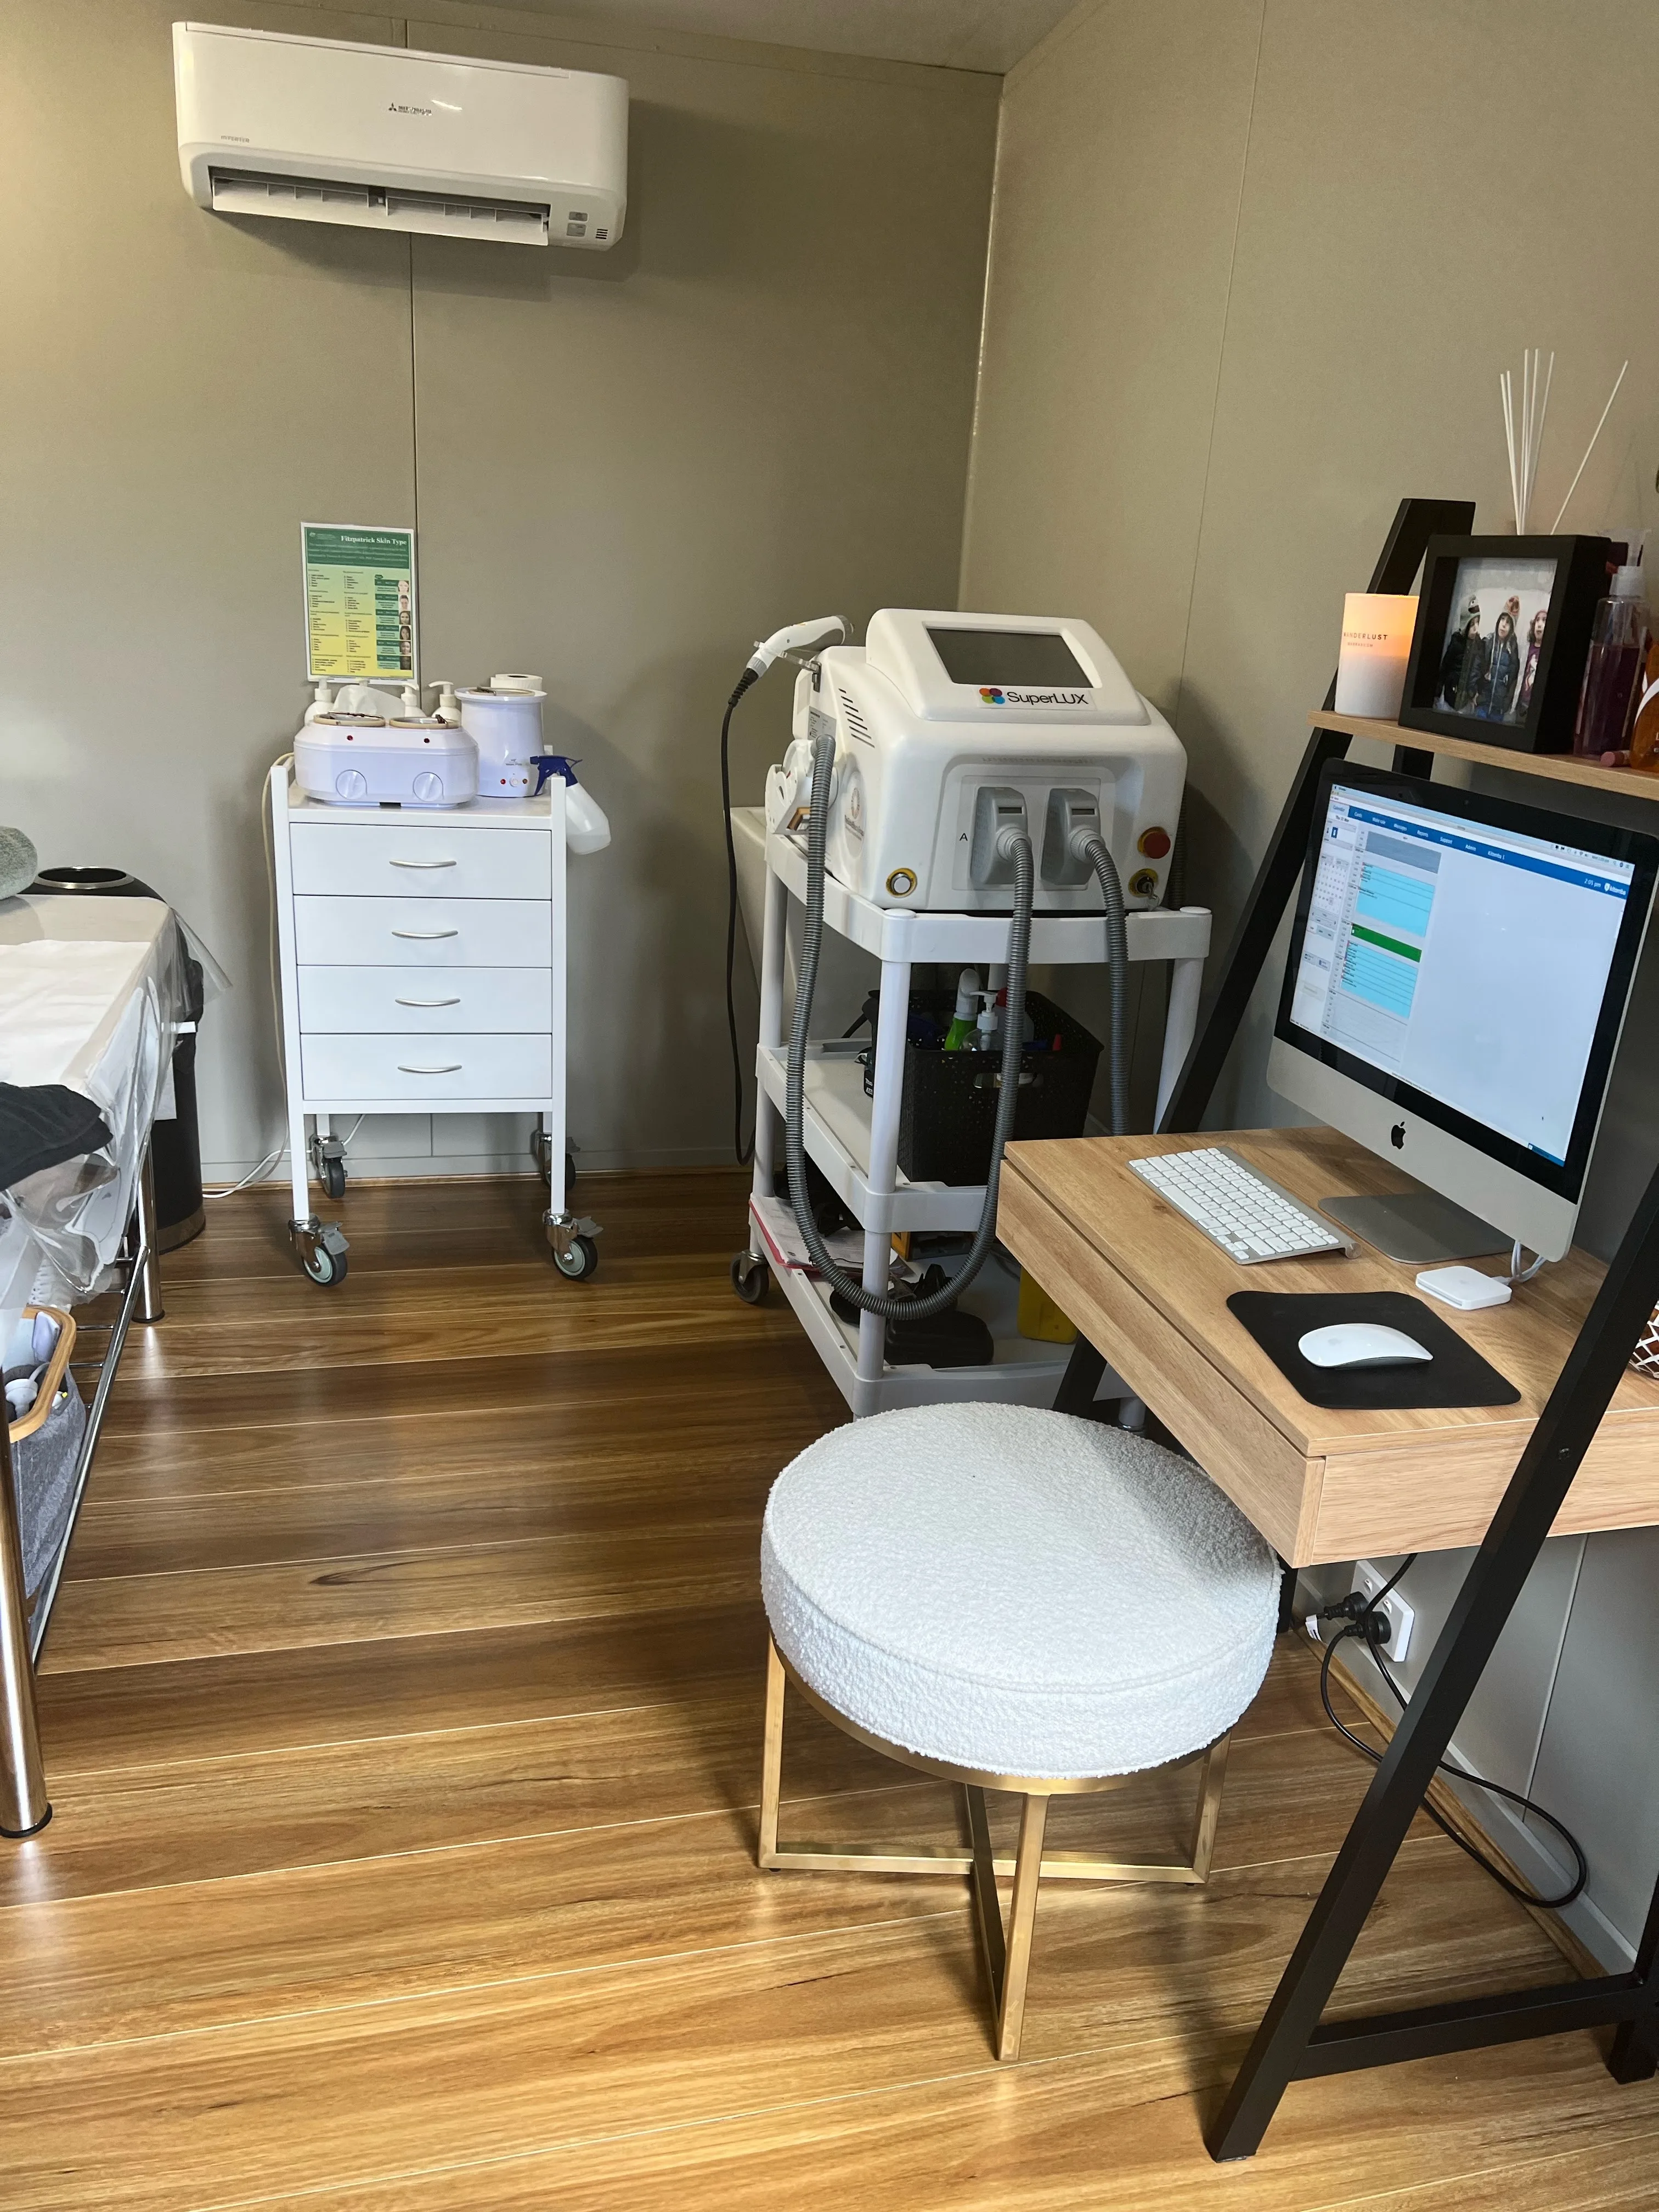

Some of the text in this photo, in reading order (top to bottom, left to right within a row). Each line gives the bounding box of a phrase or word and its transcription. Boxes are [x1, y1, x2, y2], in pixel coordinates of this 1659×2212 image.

[1344, 632, 1388, 640] WANDERLUST
[1007, 692, 1089, 706] SuperLUX
[960, 833, 968, 841] A
